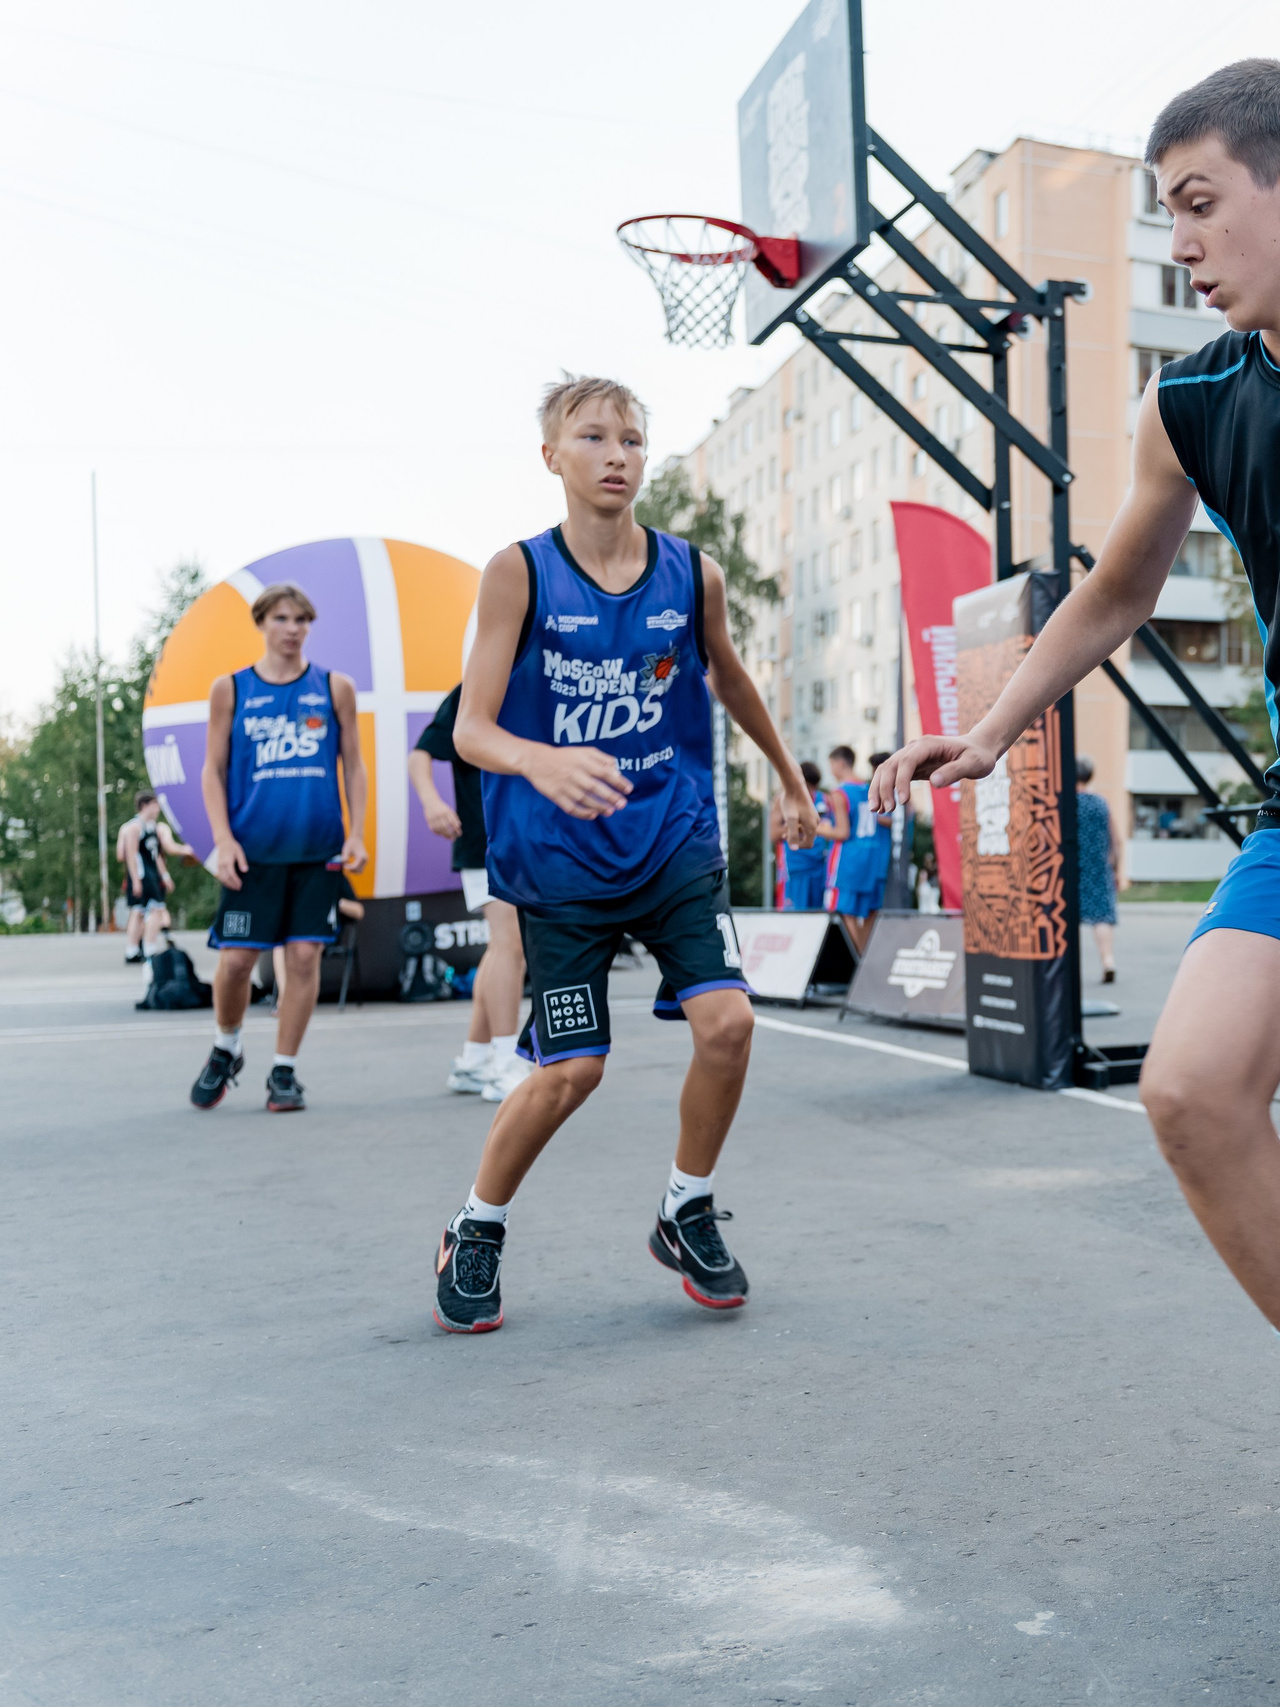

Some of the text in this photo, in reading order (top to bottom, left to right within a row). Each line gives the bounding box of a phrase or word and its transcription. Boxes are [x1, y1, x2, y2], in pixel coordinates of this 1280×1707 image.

[550, 671, 638, 701] 2023 OPEN
[553, 684, 664, 744] KIDS
[255, 732, 320, 768] KIDS
[550, 992, 585, 1007] ПОД
[551, 1003, 586, 1019] МОС
[553, 1015, 589, 1030] ТОМ
